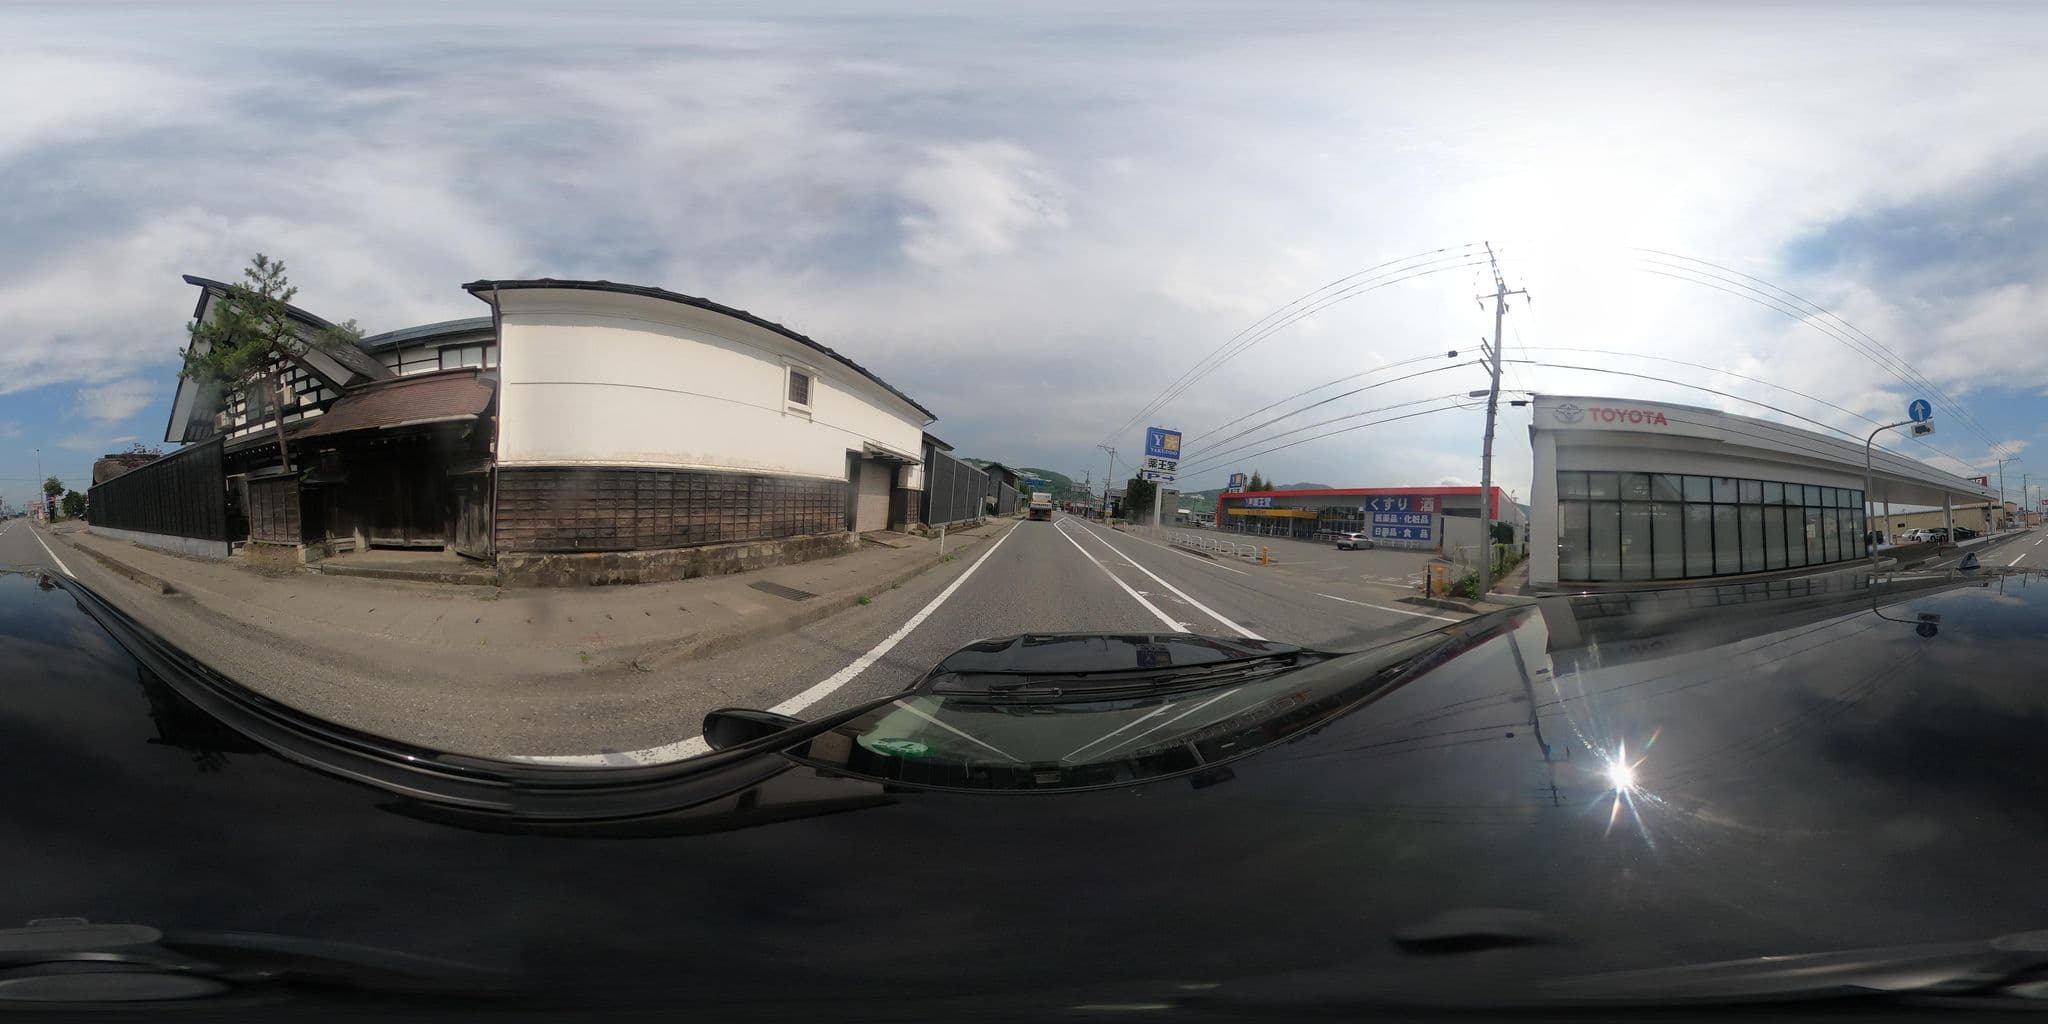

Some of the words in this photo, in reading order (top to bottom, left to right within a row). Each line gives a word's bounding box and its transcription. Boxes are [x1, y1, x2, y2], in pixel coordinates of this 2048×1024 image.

[1588, 407, 1668, 426] TOYOTA
[1153, 433, 1163, 446] Y
[1370, 497, 1407, 511] くすり
[1420, 497, 1434, 512] 酒
